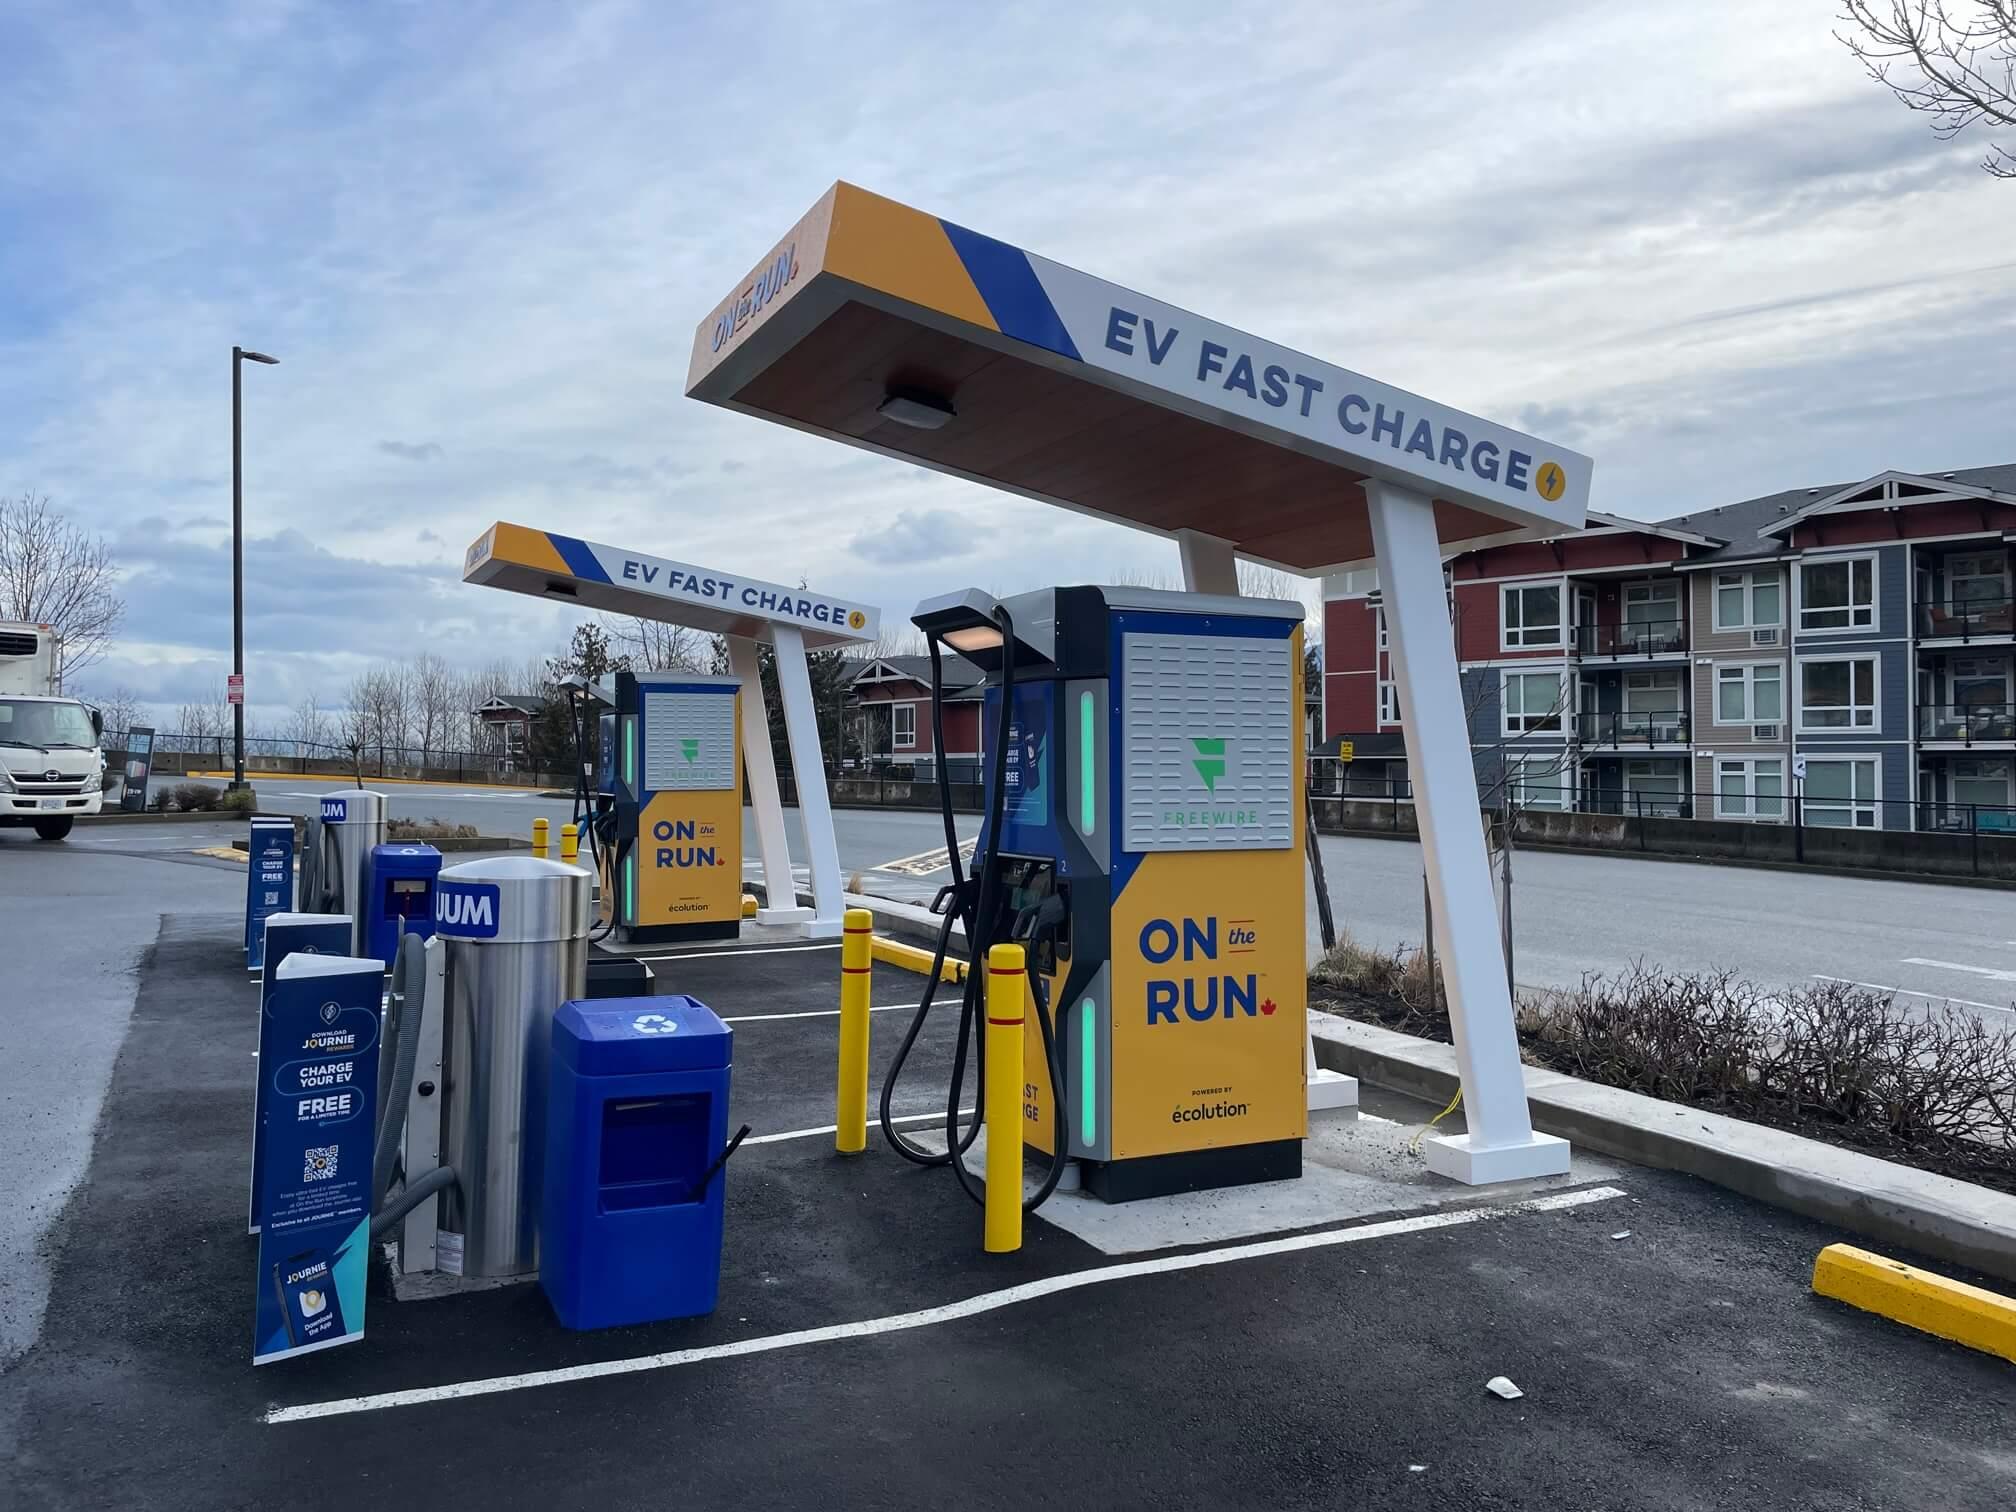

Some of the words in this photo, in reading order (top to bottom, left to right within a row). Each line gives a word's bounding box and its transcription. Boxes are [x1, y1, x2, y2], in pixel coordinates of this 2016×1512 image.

[711, 299, 740, 352] ON
[751, 242, 795, 318] RUN
[1105, 307, 1179, 365] EV
[1197, 340, 1324, 417] FAST
[1337, 394, 1532, 492] CHARGE
[623, 560, 660, 583] EV
[668, 571, 734, 600] FAST
[741, 588, 846, 626] CHARGE
[1005, 772, 1019, 782] REE
[1164, 810, 1257, 825] FREEWIRE
[653, 821, 695, 841] ON
[699, 825, 715, 834] the
[657, 848, 715, 868] RUN
[1061, 860, 1066, 872] 2
[262, 873, 283, 881] FREE
[1139, 917, 1217, 964] ON
[1228, 928, 1256, 945] the
[1147, 974, 1257, 1025] RUN
[302, 1034, 355, 1049] JOURNIE
[312, 1029, 347, 1038] DOWNLOAD
[300, 1061, 353, 1078] CHARGE
[300, 1075, 334, 1088] YOUR
[336, 1072, 353, 1083] EV
[1192, 1087, 1222, 1096] POWERED
[298, 1094, 351, 1116] FREE
[1172, 1101, 1247, 1123] écolution
[315, 1111, 337, 1119] LIMITED
[287, 1261, 327, 1284] JOURNIE
[304, 1312, 333, 1331] Download
[320, 1321, 332, 1332] App
